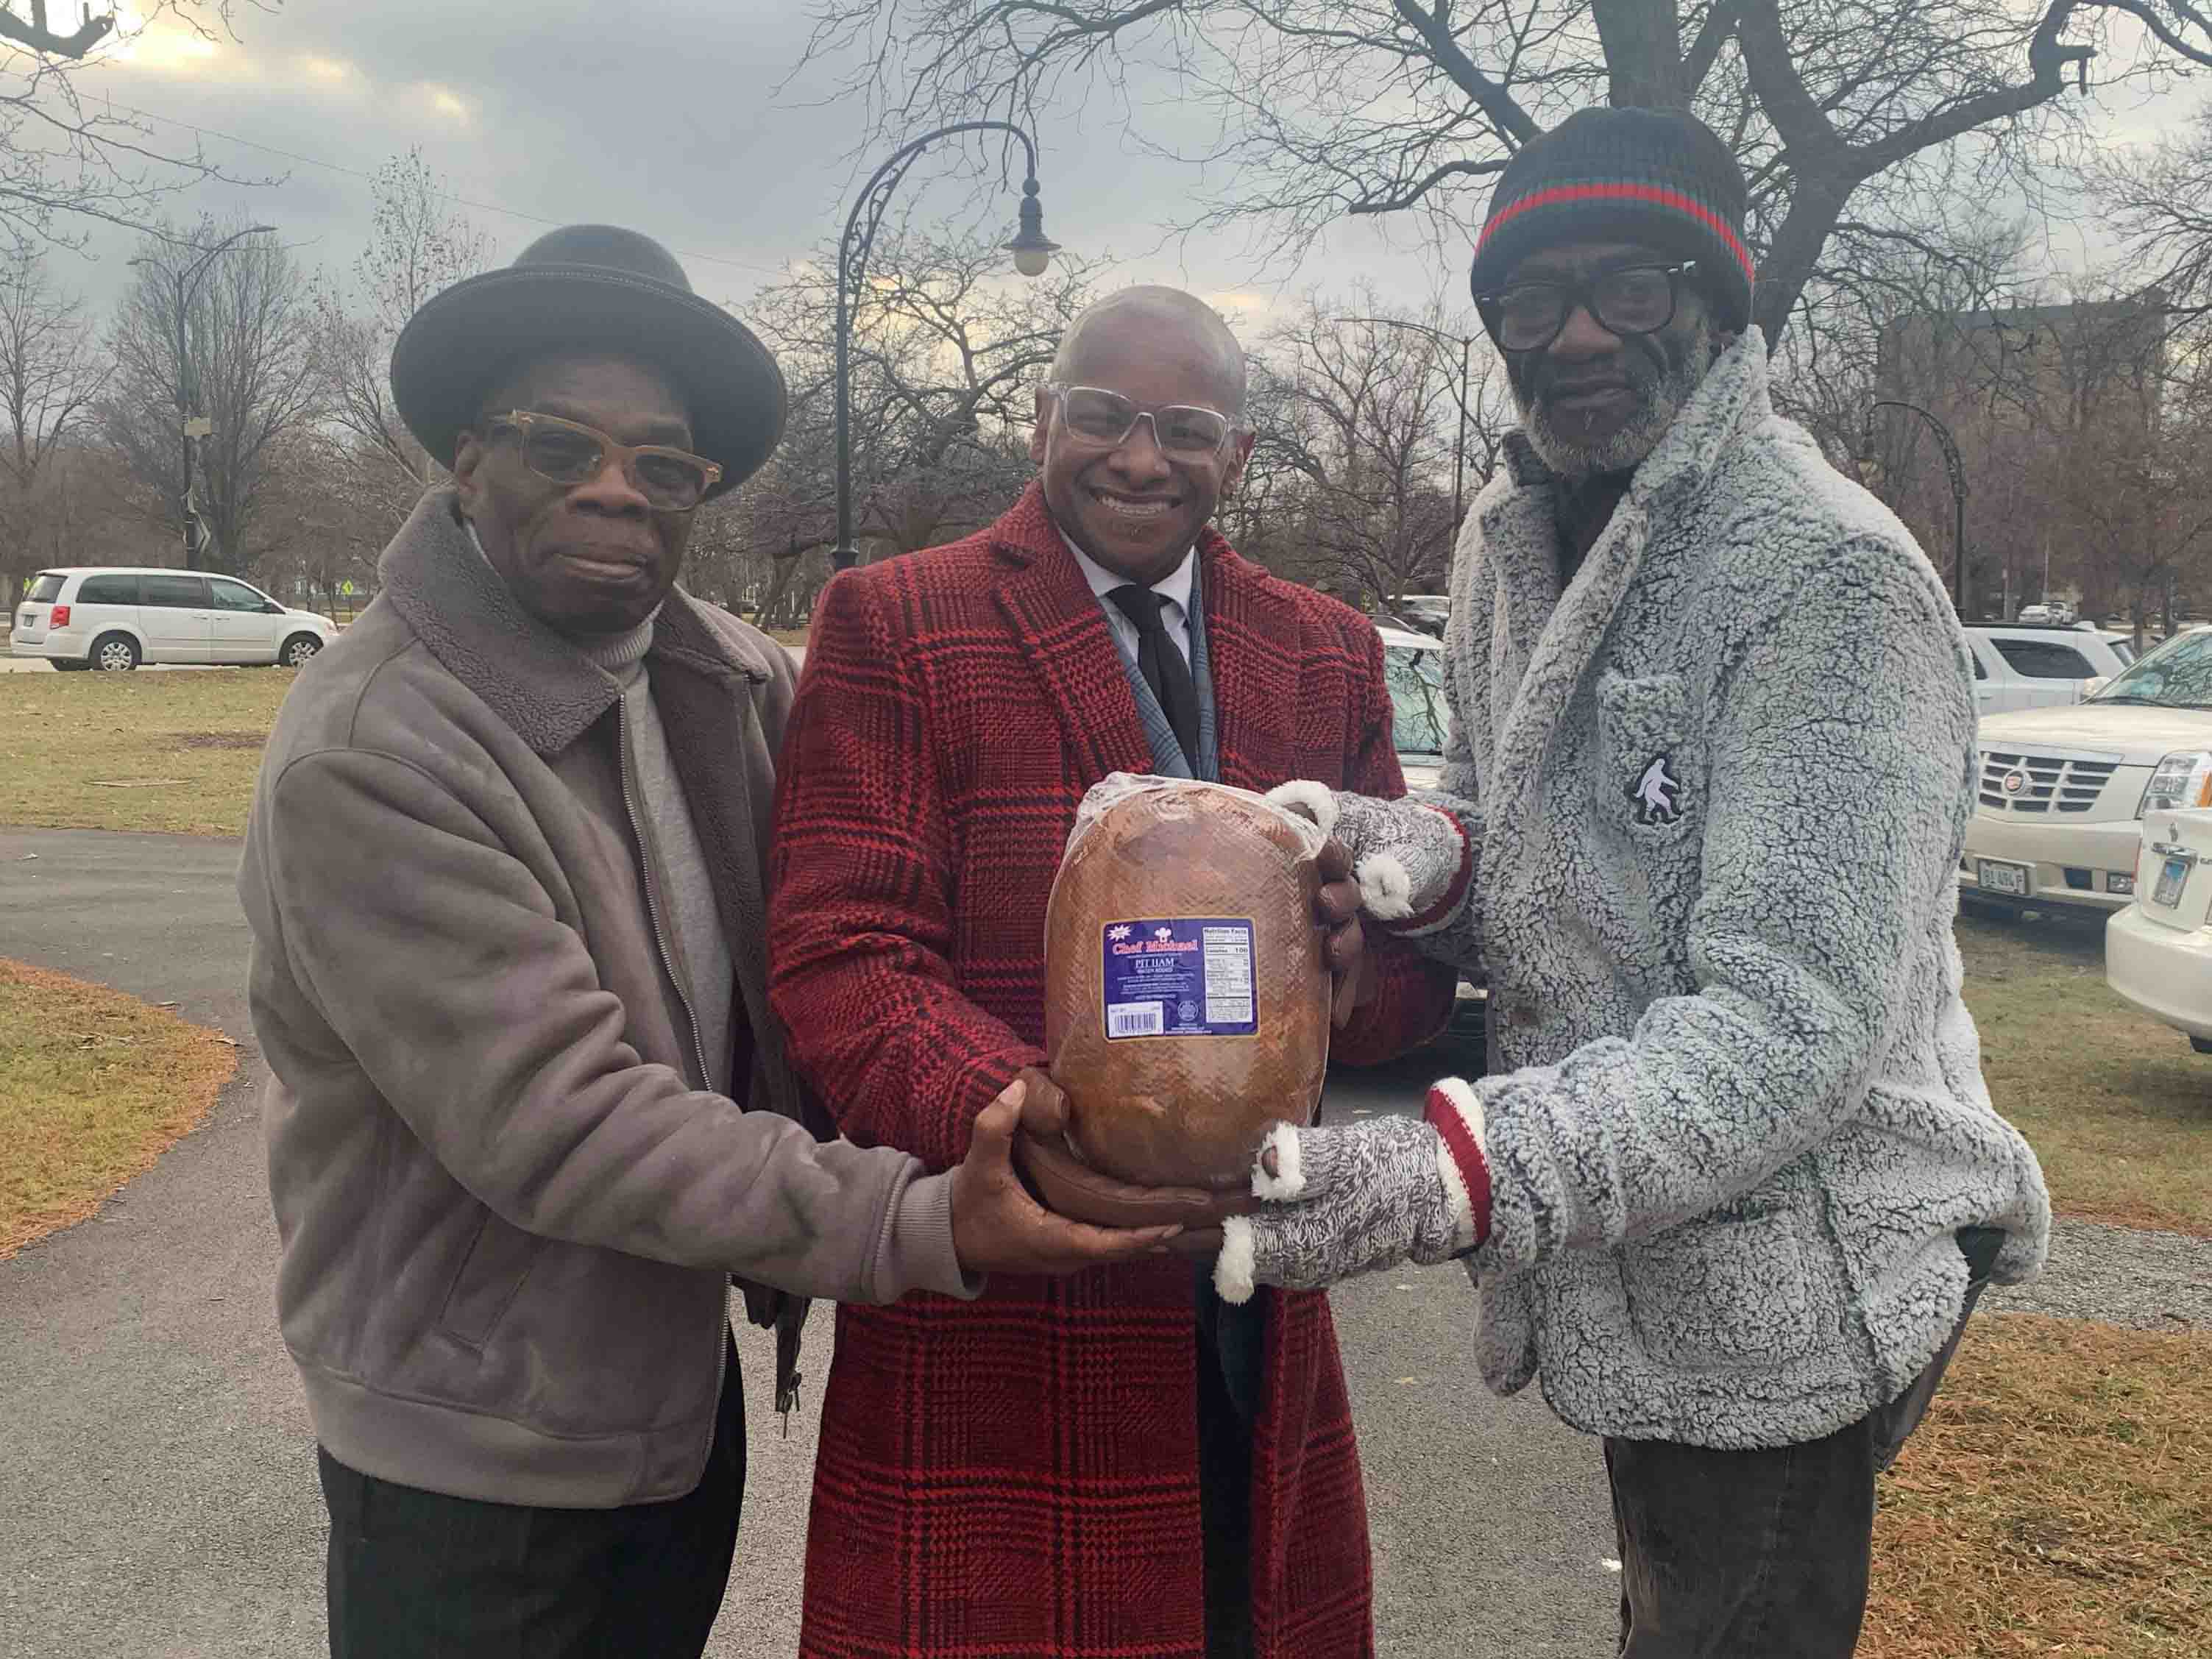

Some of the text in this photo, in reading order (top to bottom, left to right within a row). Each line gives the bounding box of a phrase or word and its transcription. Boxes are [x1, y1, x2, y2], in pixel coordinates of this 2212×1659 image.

[1112, 939, 1199, 954] Chef Michael
[1135, 958, 1174, 968] PIT HAM
